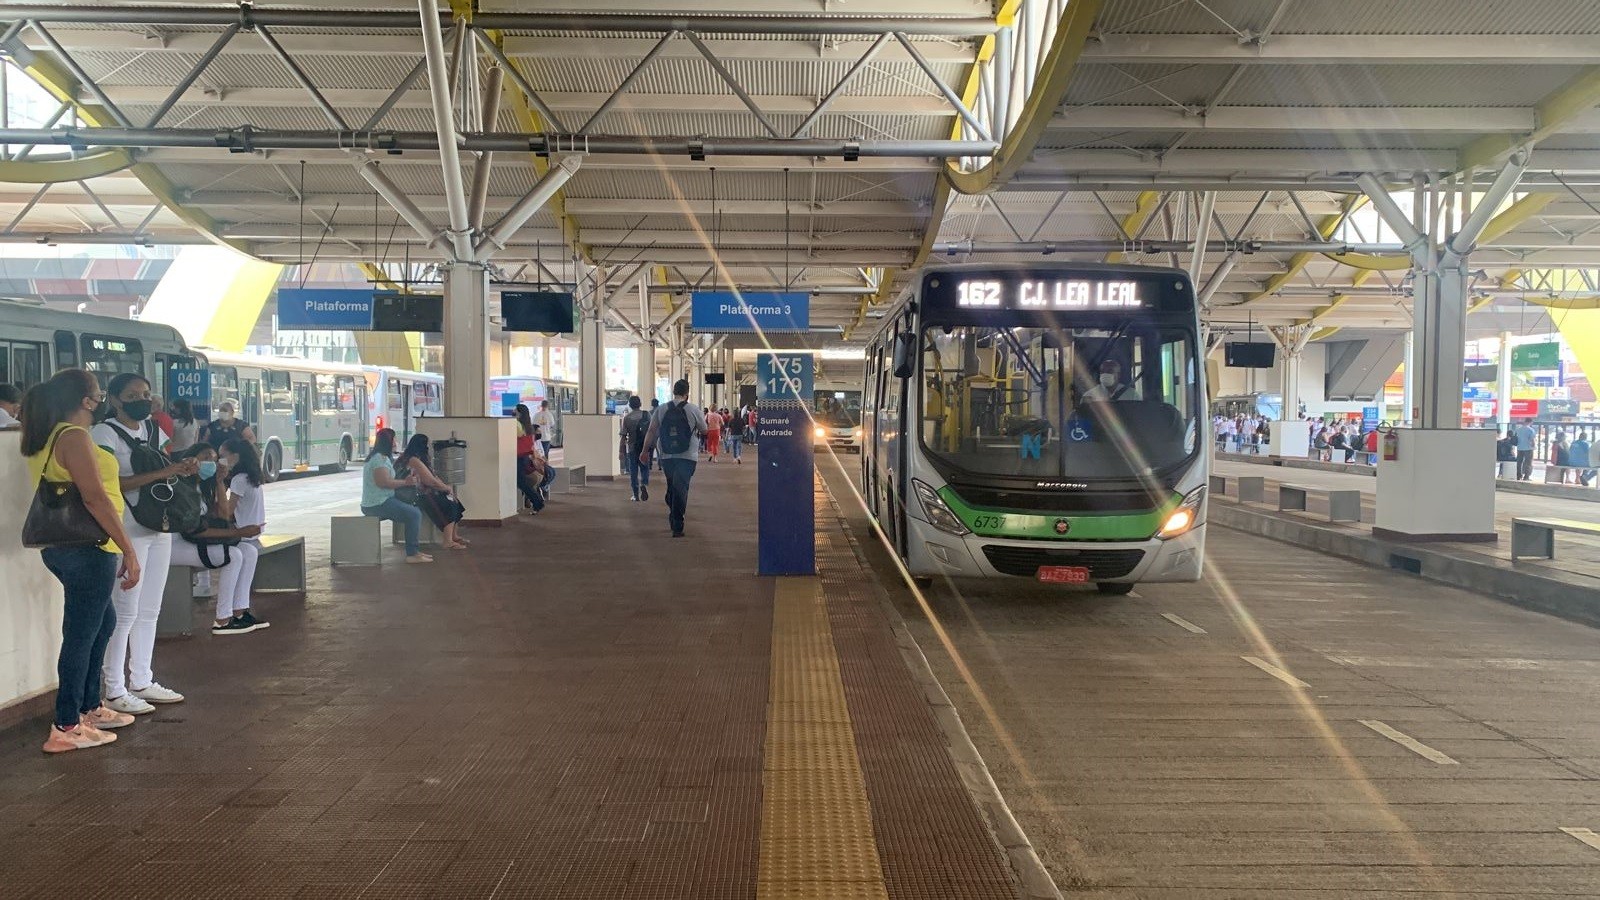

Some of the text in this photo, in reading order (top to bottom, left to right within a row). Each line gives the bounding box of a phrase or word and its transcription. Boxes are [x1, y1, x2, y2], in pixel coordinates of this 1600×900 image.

[957, 281, 1142, 306] 162 CJ. LEA LEAL
[305, 300, 369, 312] Plataforma
[720, 304, 791, 315] Plataforma 3
[767, 357, 803, 374] 175
[177, 372, 201, 384] 040
[177, 385, 200, 397] 041
[767, 377, 803, 394] 179
[760, 416, 790, 426] Sumaré
[760, 429, 793, 437] Andrade
[973, 515, 1007, 529] 6737
